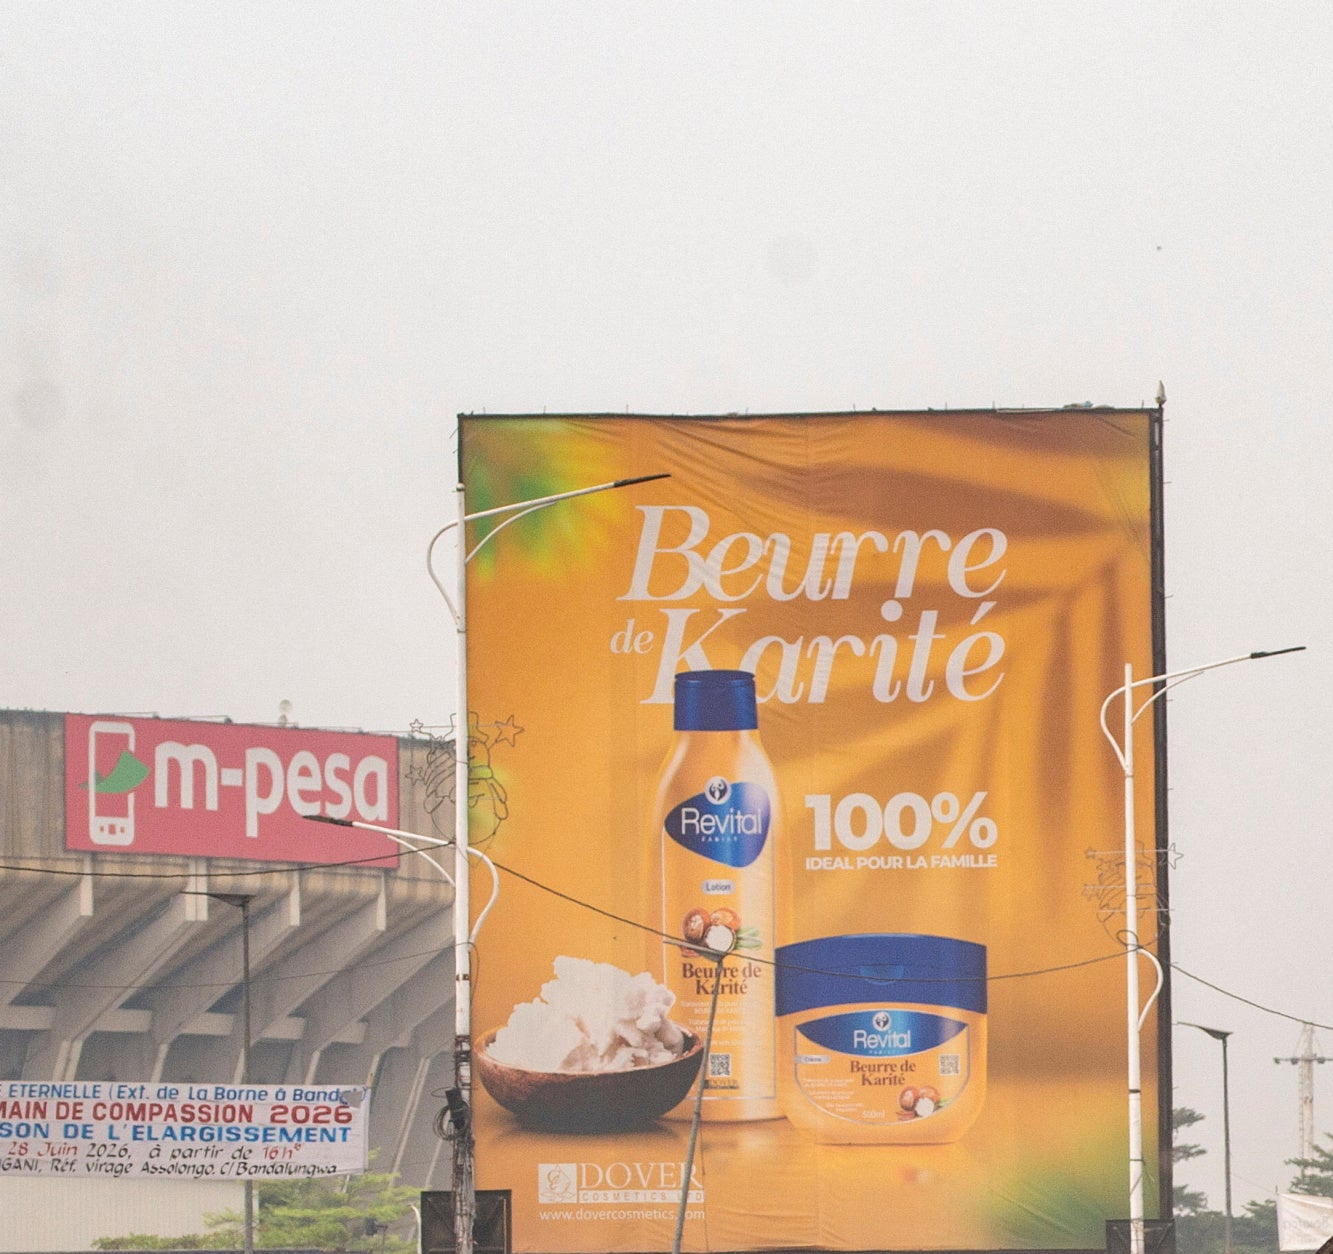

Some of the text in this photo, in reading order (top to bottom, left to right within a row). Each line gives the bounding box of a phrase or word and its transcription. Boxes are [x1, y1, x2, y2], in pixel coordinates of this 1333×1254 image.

[615, 504, 1009, 602] Beurre
[610, 599, 1007, 705] de Karité
[154, 741, 390, 838] m-pesa
[680, 807, 763, 835] Revital
[804, 791, 999, 852] 100%
[805, 854, 998, 871] IDEAL POUR LA FAMILLE
[741, 962, 762, 978] de
[853, 1029, 911, 1049] Revital
[850, 1060, 917, 1074] Beurre de
[860, 1073, 906, 1087] Karité
[8, 1083, 101, 1100] ETERNELLE
[156, 1086, 179, 1100] de
[188, 1087, 208, 1100] La
[214, 1088, 268, 1101] Borne
[55, 1102, 84, 1122] DE
[92, 1103, 254, 1124] COMPASSION
[270, 1104, 353, 1125] 2026
[64, 1123, 95, 1139] DE
[37, 1142, 78, 1157] Juin
[169, 1145, 224, 1161] partir
[231, 1146, 253, 1160] de
[86, 1160, 133, 1178] virage
[579, 1161, 704, 1189] DOVER
[582, 1191, 667, 1201] COSMETICS
[539, 1207, 705, 1221] www.dovercosmetics.om
